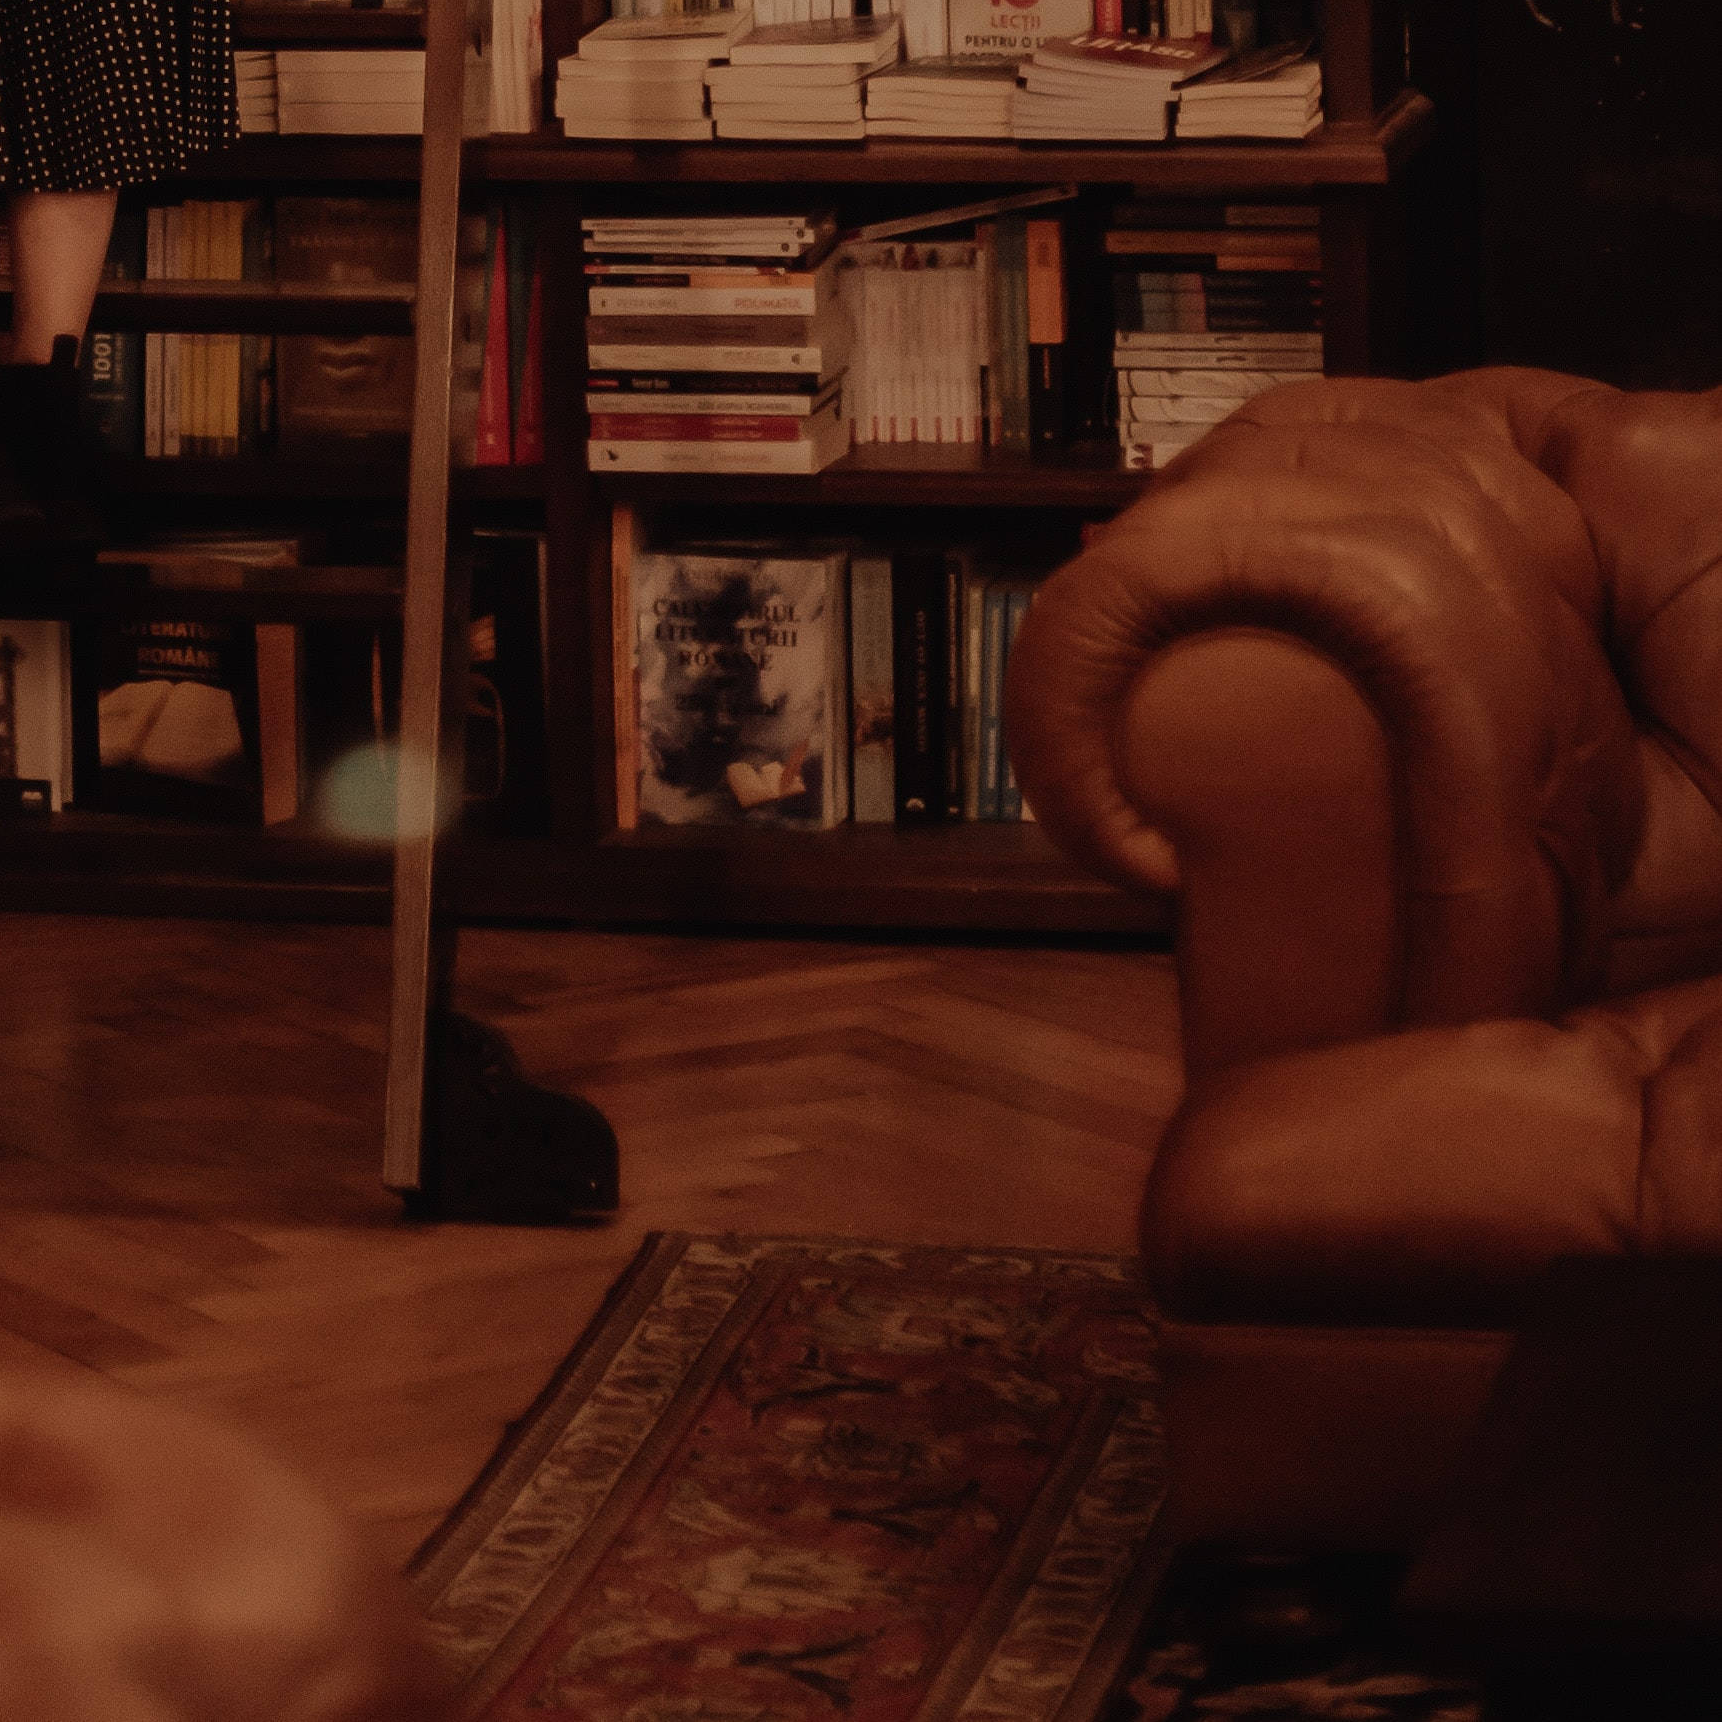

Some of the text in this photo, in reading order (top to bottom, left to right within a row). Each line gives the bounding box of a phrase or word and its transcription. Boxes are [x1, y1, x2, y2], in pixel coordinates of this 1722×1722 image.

[965, 35, 1033, 49] PENTRU O
[92, 331, 112, 382] 1001
